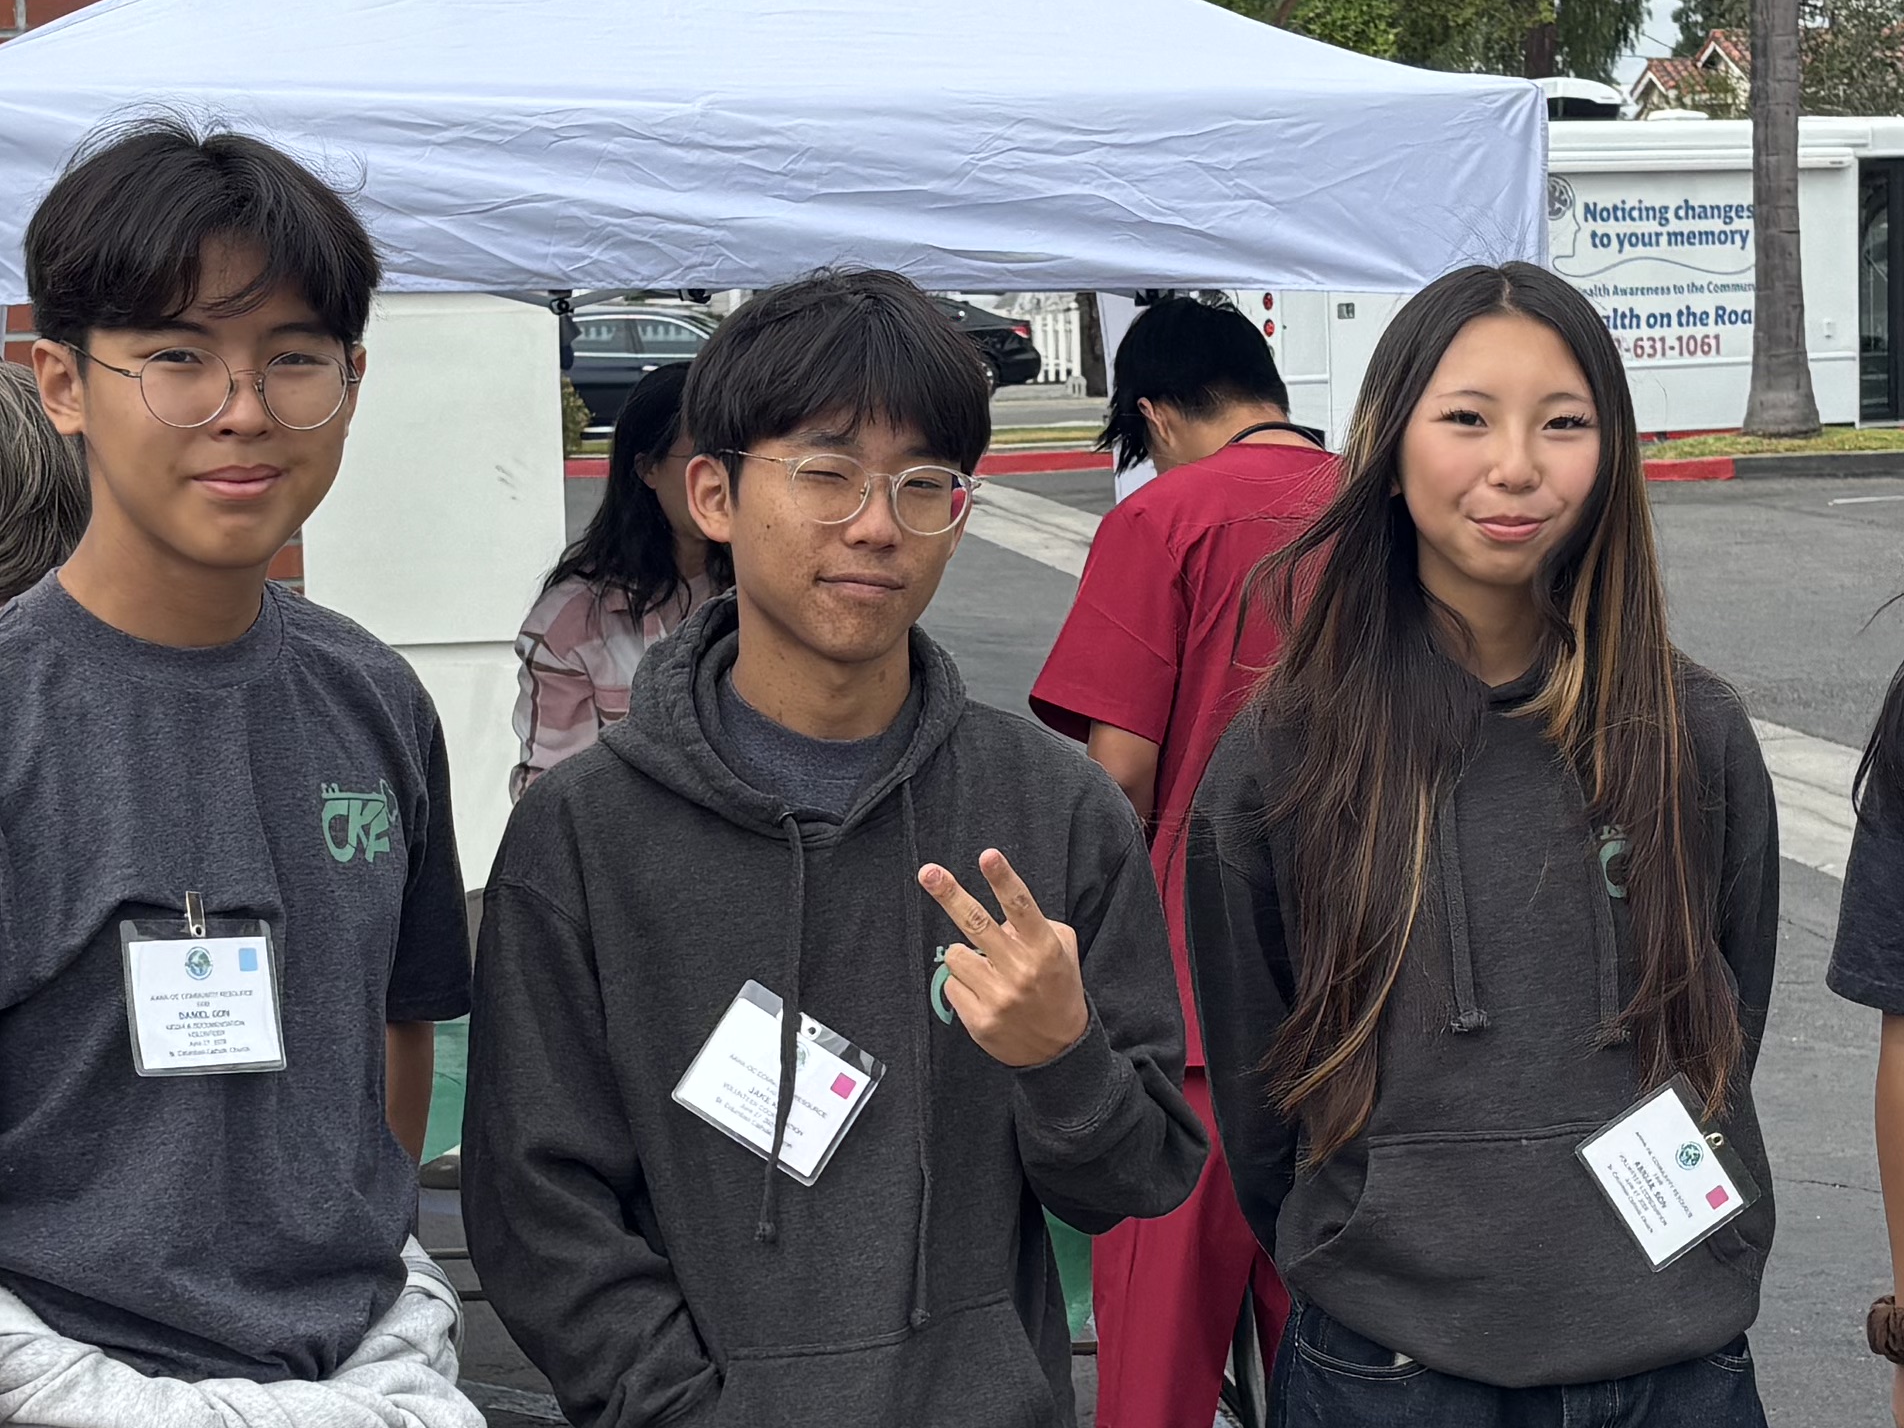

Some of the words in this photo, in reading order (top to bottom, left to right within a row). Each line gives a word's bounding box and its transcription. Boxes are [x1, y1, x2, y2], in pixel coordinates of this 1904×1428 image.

[1583, 199, 1670, 227] Noticing
[1674, 198, 1755, 225] changes
[1590, 229, 1611, 249] to
[1615, 231, 1663, 254] your
[1667, 229, 1750, 251] memory
[1612, 283, 1671, 297] Awareness
[1673, 283, 1684, 295] to
[1687, 282, 1705, 294] the
[1707, 281, 1755, 294] Commun
[1602, 307, 1641, 330] alth
[1646, 311, 1672, 329] on
[1676, 305, 1710, 327] the
[1714, 305, 1753, 326] Roa
